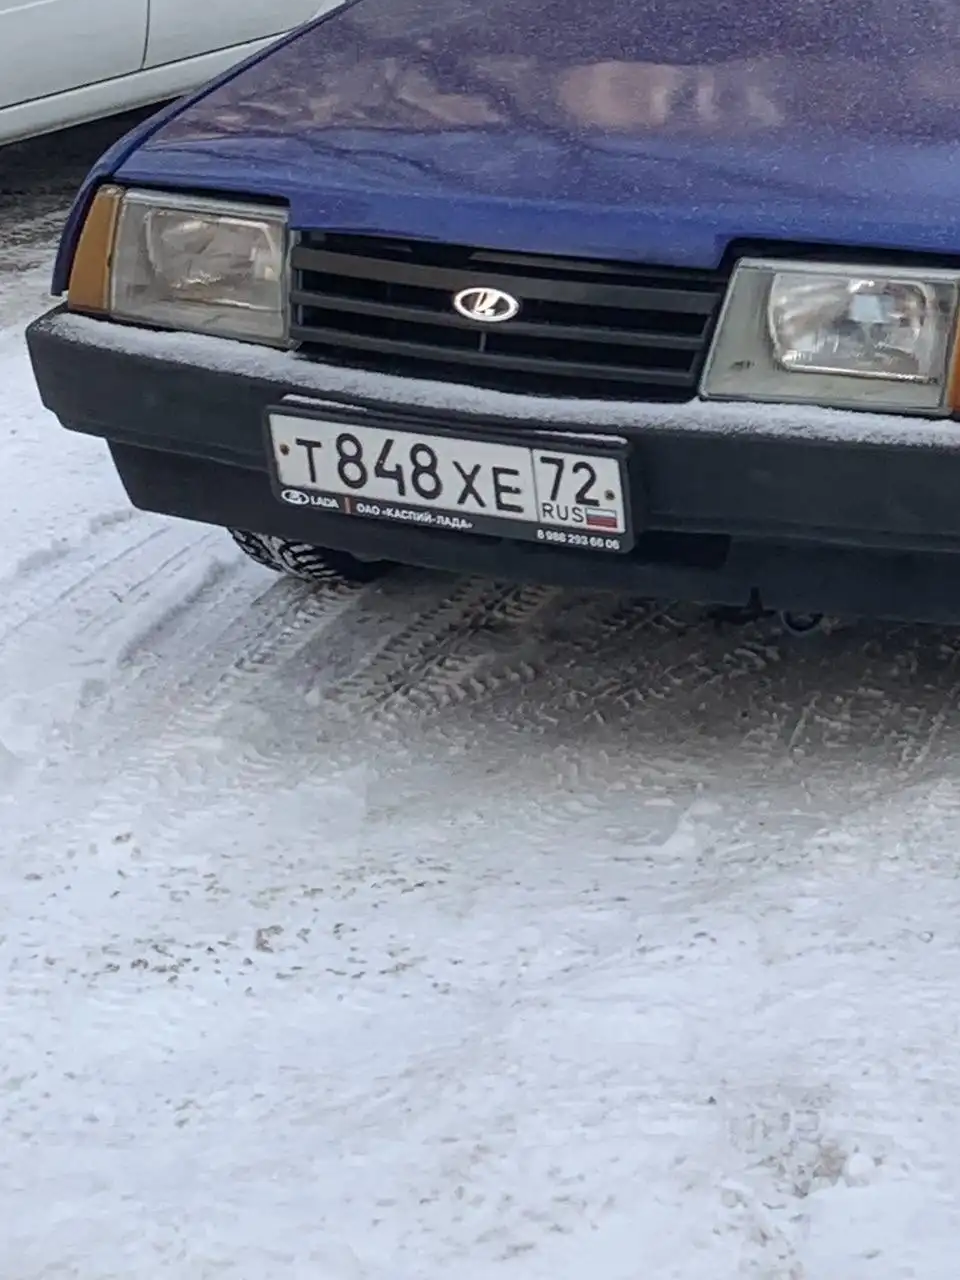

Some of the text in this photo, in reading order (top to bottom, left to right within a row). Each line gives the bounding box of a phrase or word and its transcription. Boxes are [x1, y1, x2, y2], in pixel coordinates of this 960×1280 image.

[539, 455, 600, 508] 72
[310, 495, 340, 509] LADA
[355, 502, 381, 517] ОАО
[541, 501, 585, 524] RUS
